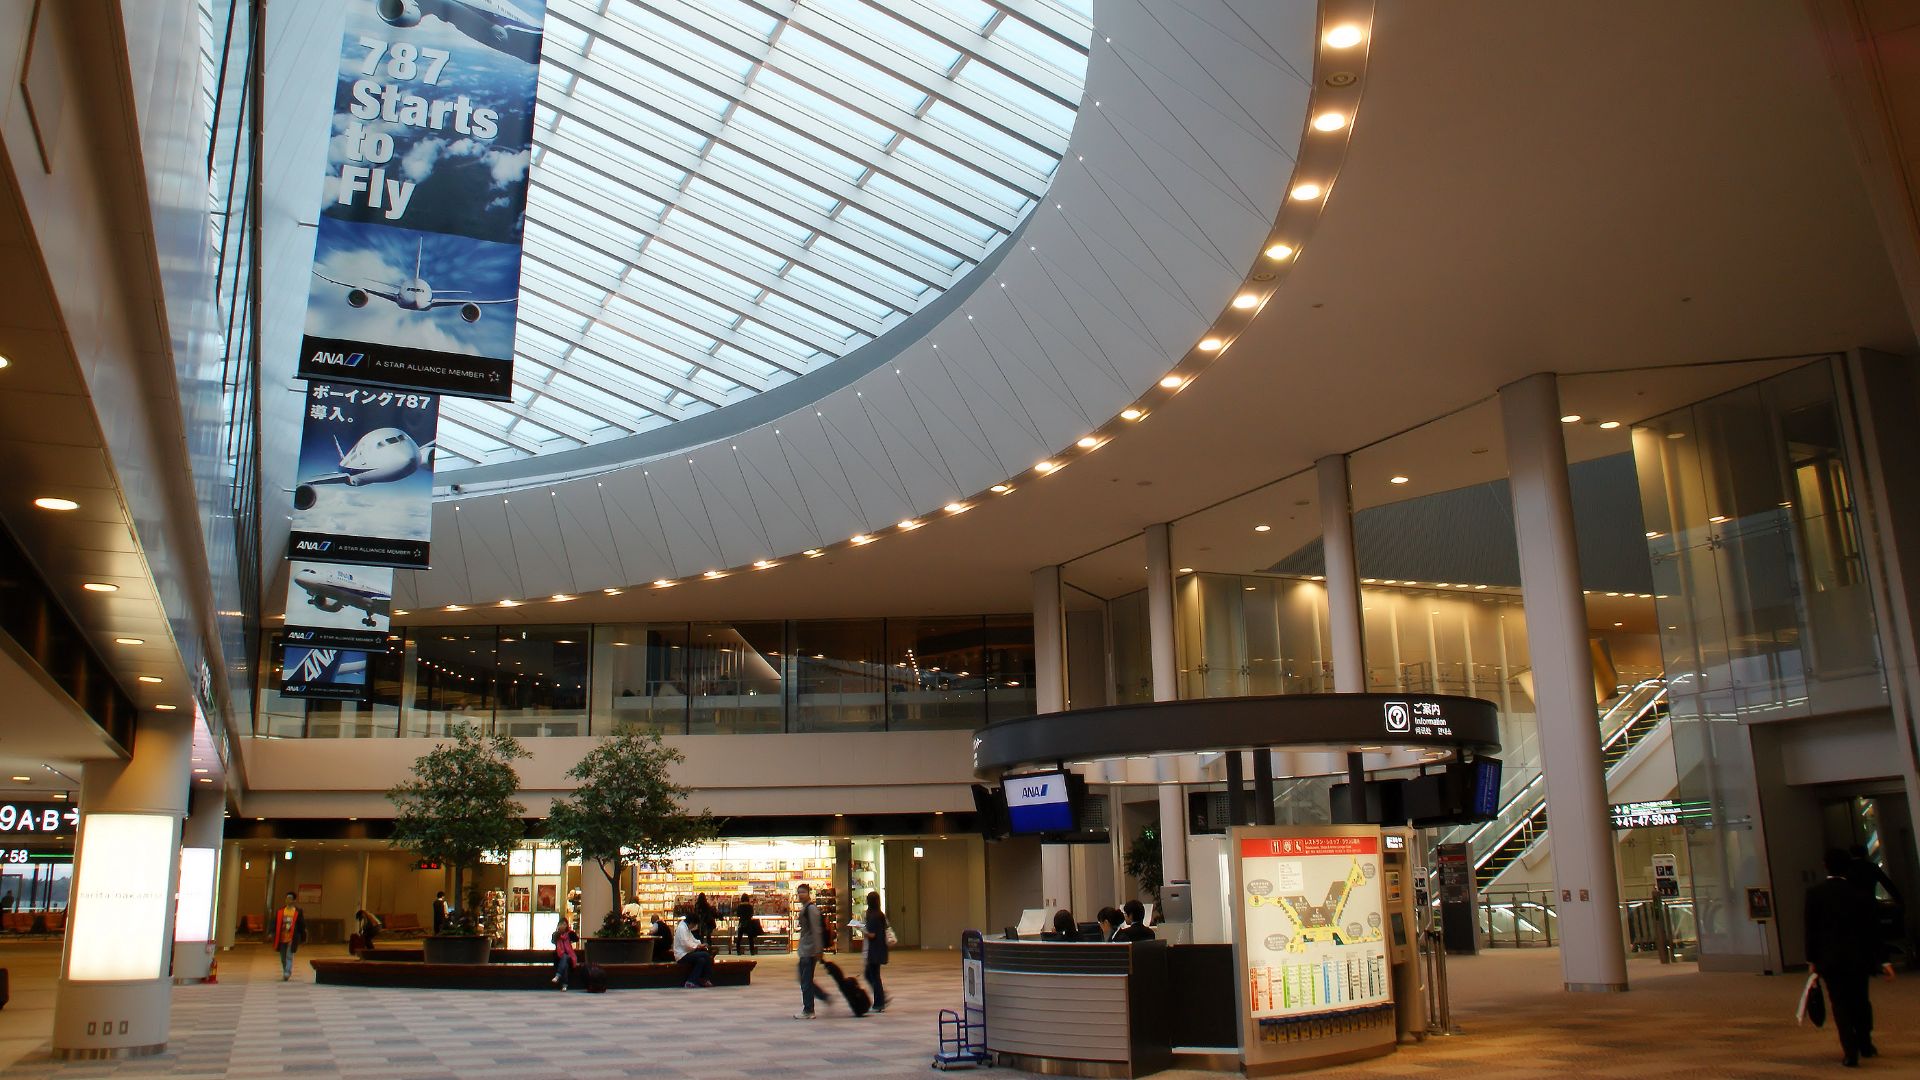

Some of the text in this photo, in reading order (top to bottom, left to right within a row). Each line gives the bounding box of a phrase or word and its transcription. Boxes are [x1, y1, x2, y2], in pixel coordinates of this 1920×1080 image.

[360, 36, 450, 86] 787
[350, 79, 499, 139] Starts
[345, 121, 394, 164] to
[338, 164, 416, 220] Fly
[312, 351, 345, 365] ANA
[384, 361, 405, 369] STAR
[407, 364, 447, 375] ALLIANCE
[448, 368, 485, 379] MEMBER
[312, 385, 431, 409] ボーイング787
[310, 404, 354, 423] 導入。
[296, 540, 318, 550] ANA
[288, 631, 305, 640] ANA
[1413, 703, 1440, 715] ご案内
[1415, 717, 1446, 725] Information
[1022, 786, 1041, 798] ANA
